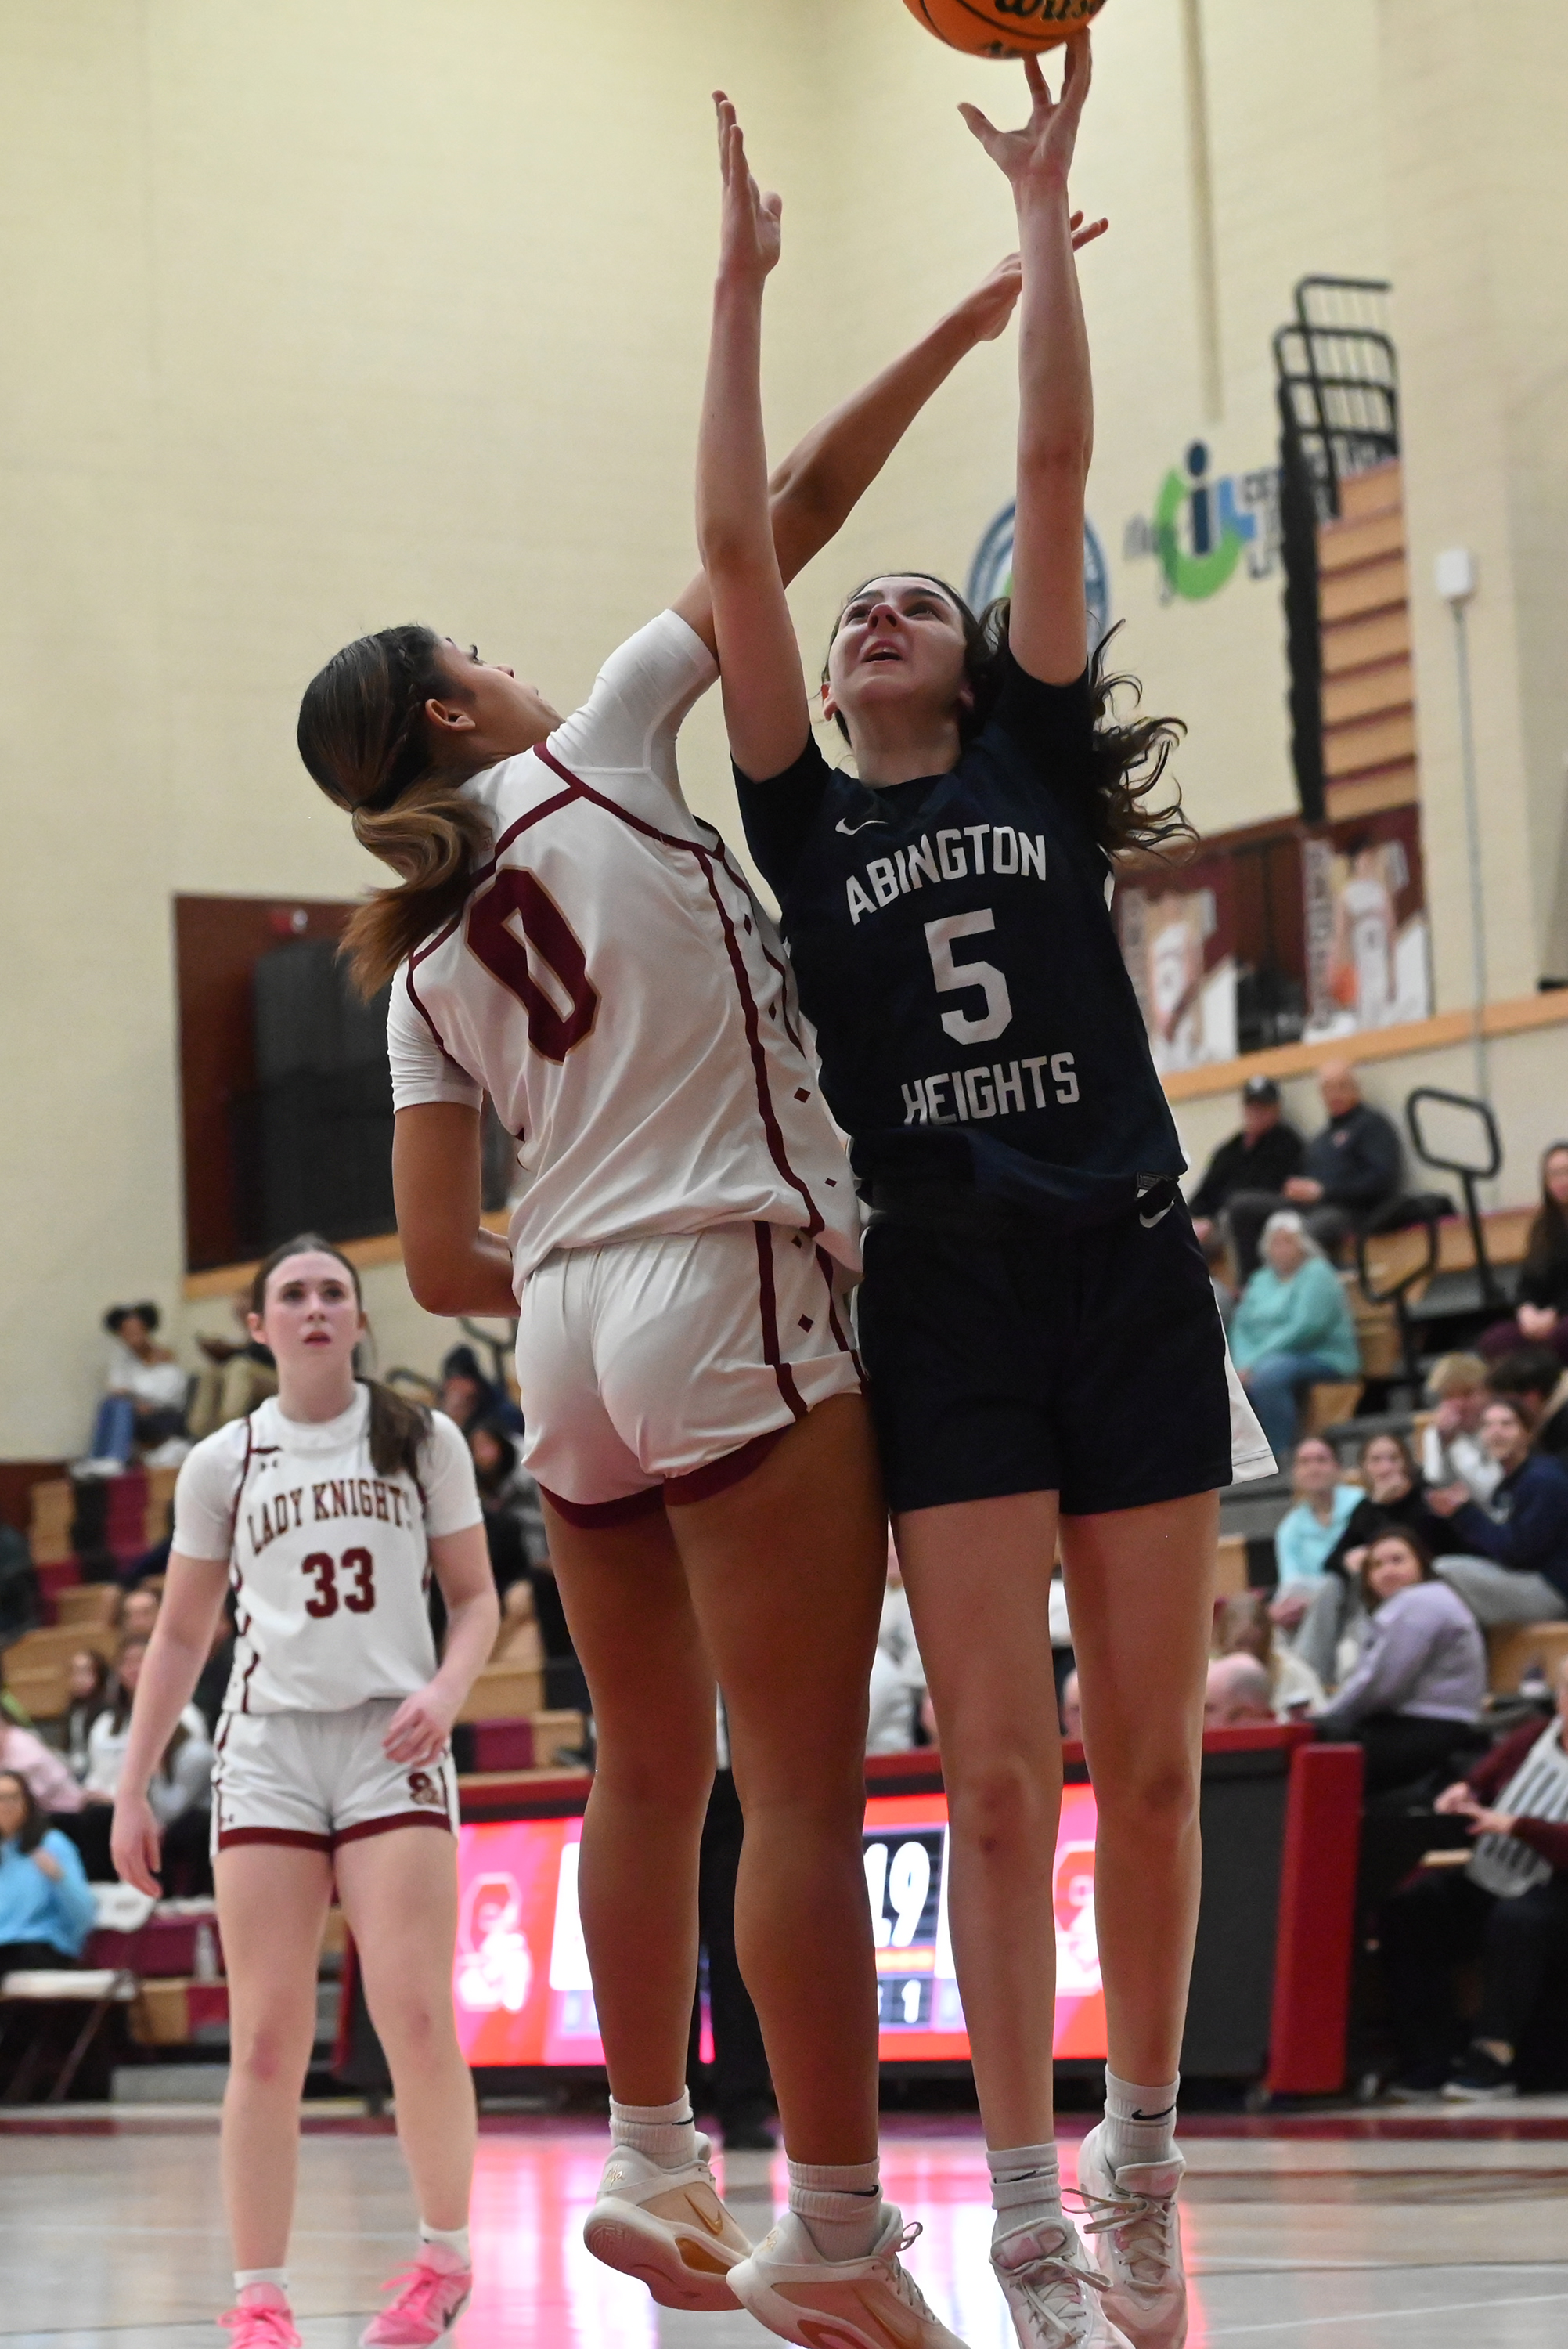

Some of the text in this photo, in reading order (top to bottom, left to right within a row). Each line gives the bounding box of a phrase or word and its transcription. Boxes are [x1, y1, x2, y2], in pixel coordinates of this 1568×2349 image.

[845, 824, 1047, 926] ABINGTON
[464, 864, 602, 1066] 0
[924, 908, 1013, 1045] 5
[901, 1052, 1080, 1126] HEIGHTS
[247, 1486, 303, 1557] LADY
[301, 1546, 376, 1618] 33
